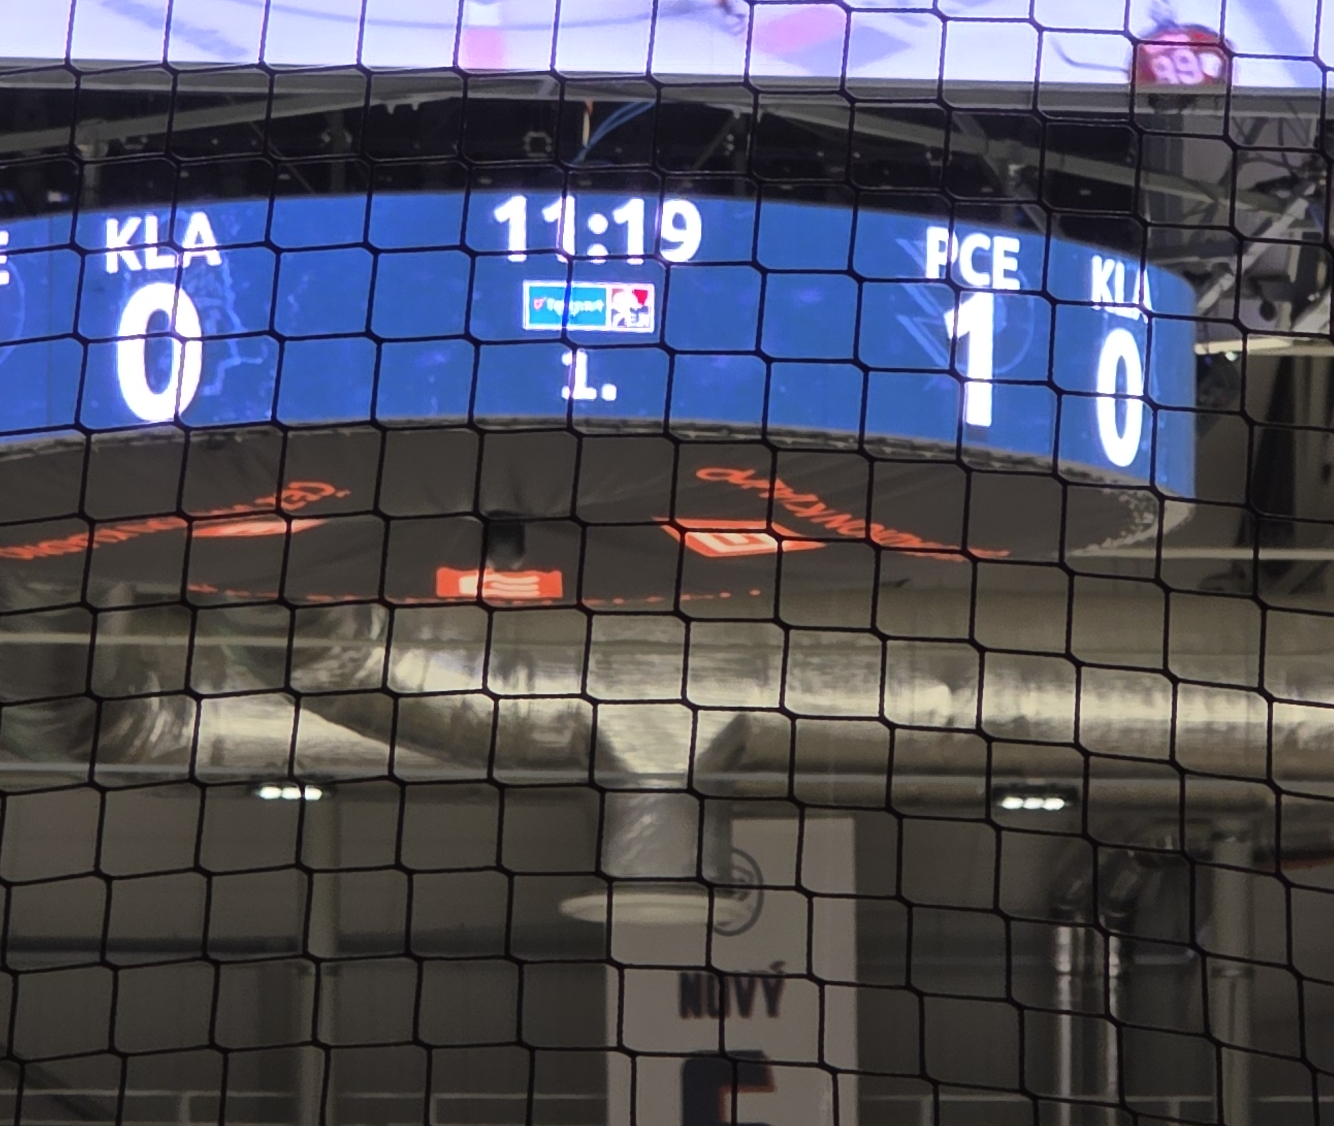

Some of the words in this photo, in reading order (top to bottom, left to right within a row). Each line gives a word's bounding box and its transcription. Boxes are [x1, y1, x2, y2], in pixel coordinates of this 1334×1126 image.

[105, 211, 222, 274] KLA
[493, 194, 703, 264] 11:19
[925, 225, 1021, 290] PCE
[1091, 255, 1152, 323] KLA
[118, 281, 203, 423] 0
[562, 348, 618, 400] 1.
[943, 293, 994, 427] 1
[1096, 327, 1145, 468] 0
[678, 960, 786, 1020] NOVÝ
